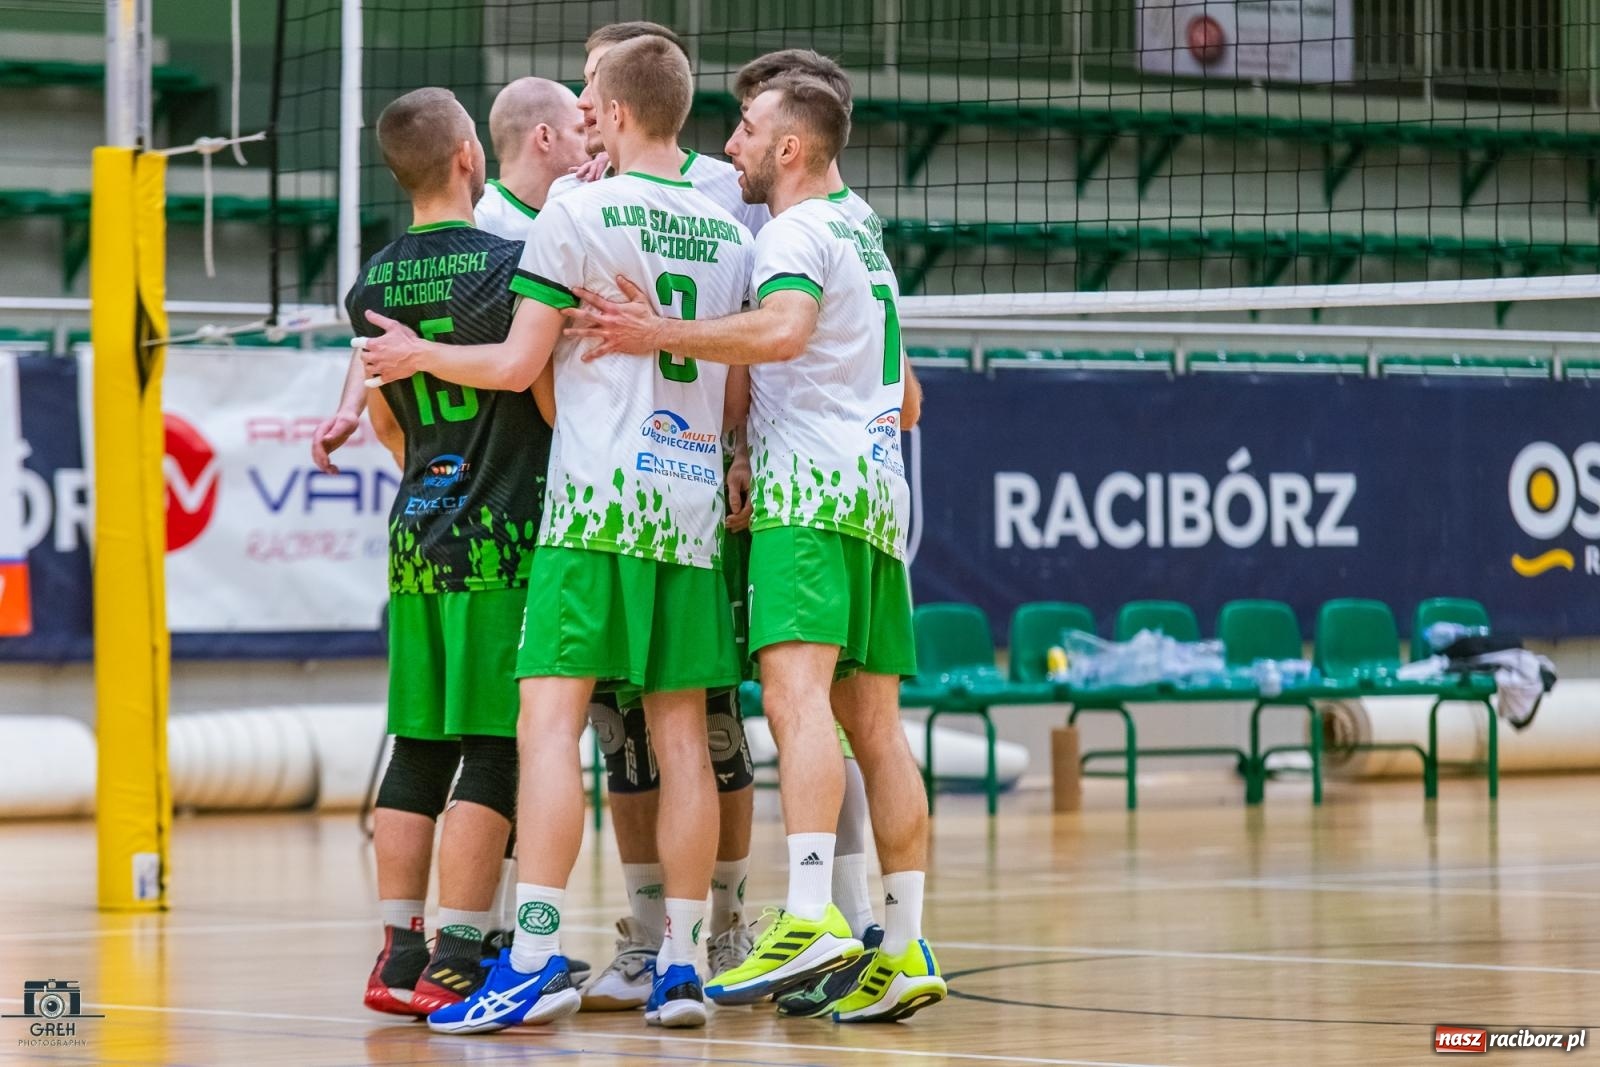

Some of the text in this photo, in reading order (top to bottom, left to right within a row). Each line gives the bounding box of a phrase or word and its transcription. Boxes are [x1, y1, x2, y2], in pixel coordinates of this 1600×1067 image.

[601, 205, 742, 245] KLUB SIATKARSKI
[640, 229, 719, 264] RACIBÓRZ
[397, 251, 489, 282] SIATKARSKI
[383, 278, 454, 308] RACIBÓRZ
[656, 271, 699, 383] 3
[868, 281, 901, 386] 7
[682, 431, 718, 443] MULTI
[636, 452, 717, 481] ENTECO
[994, 446, 1360, 550] RACIBÓRZ
